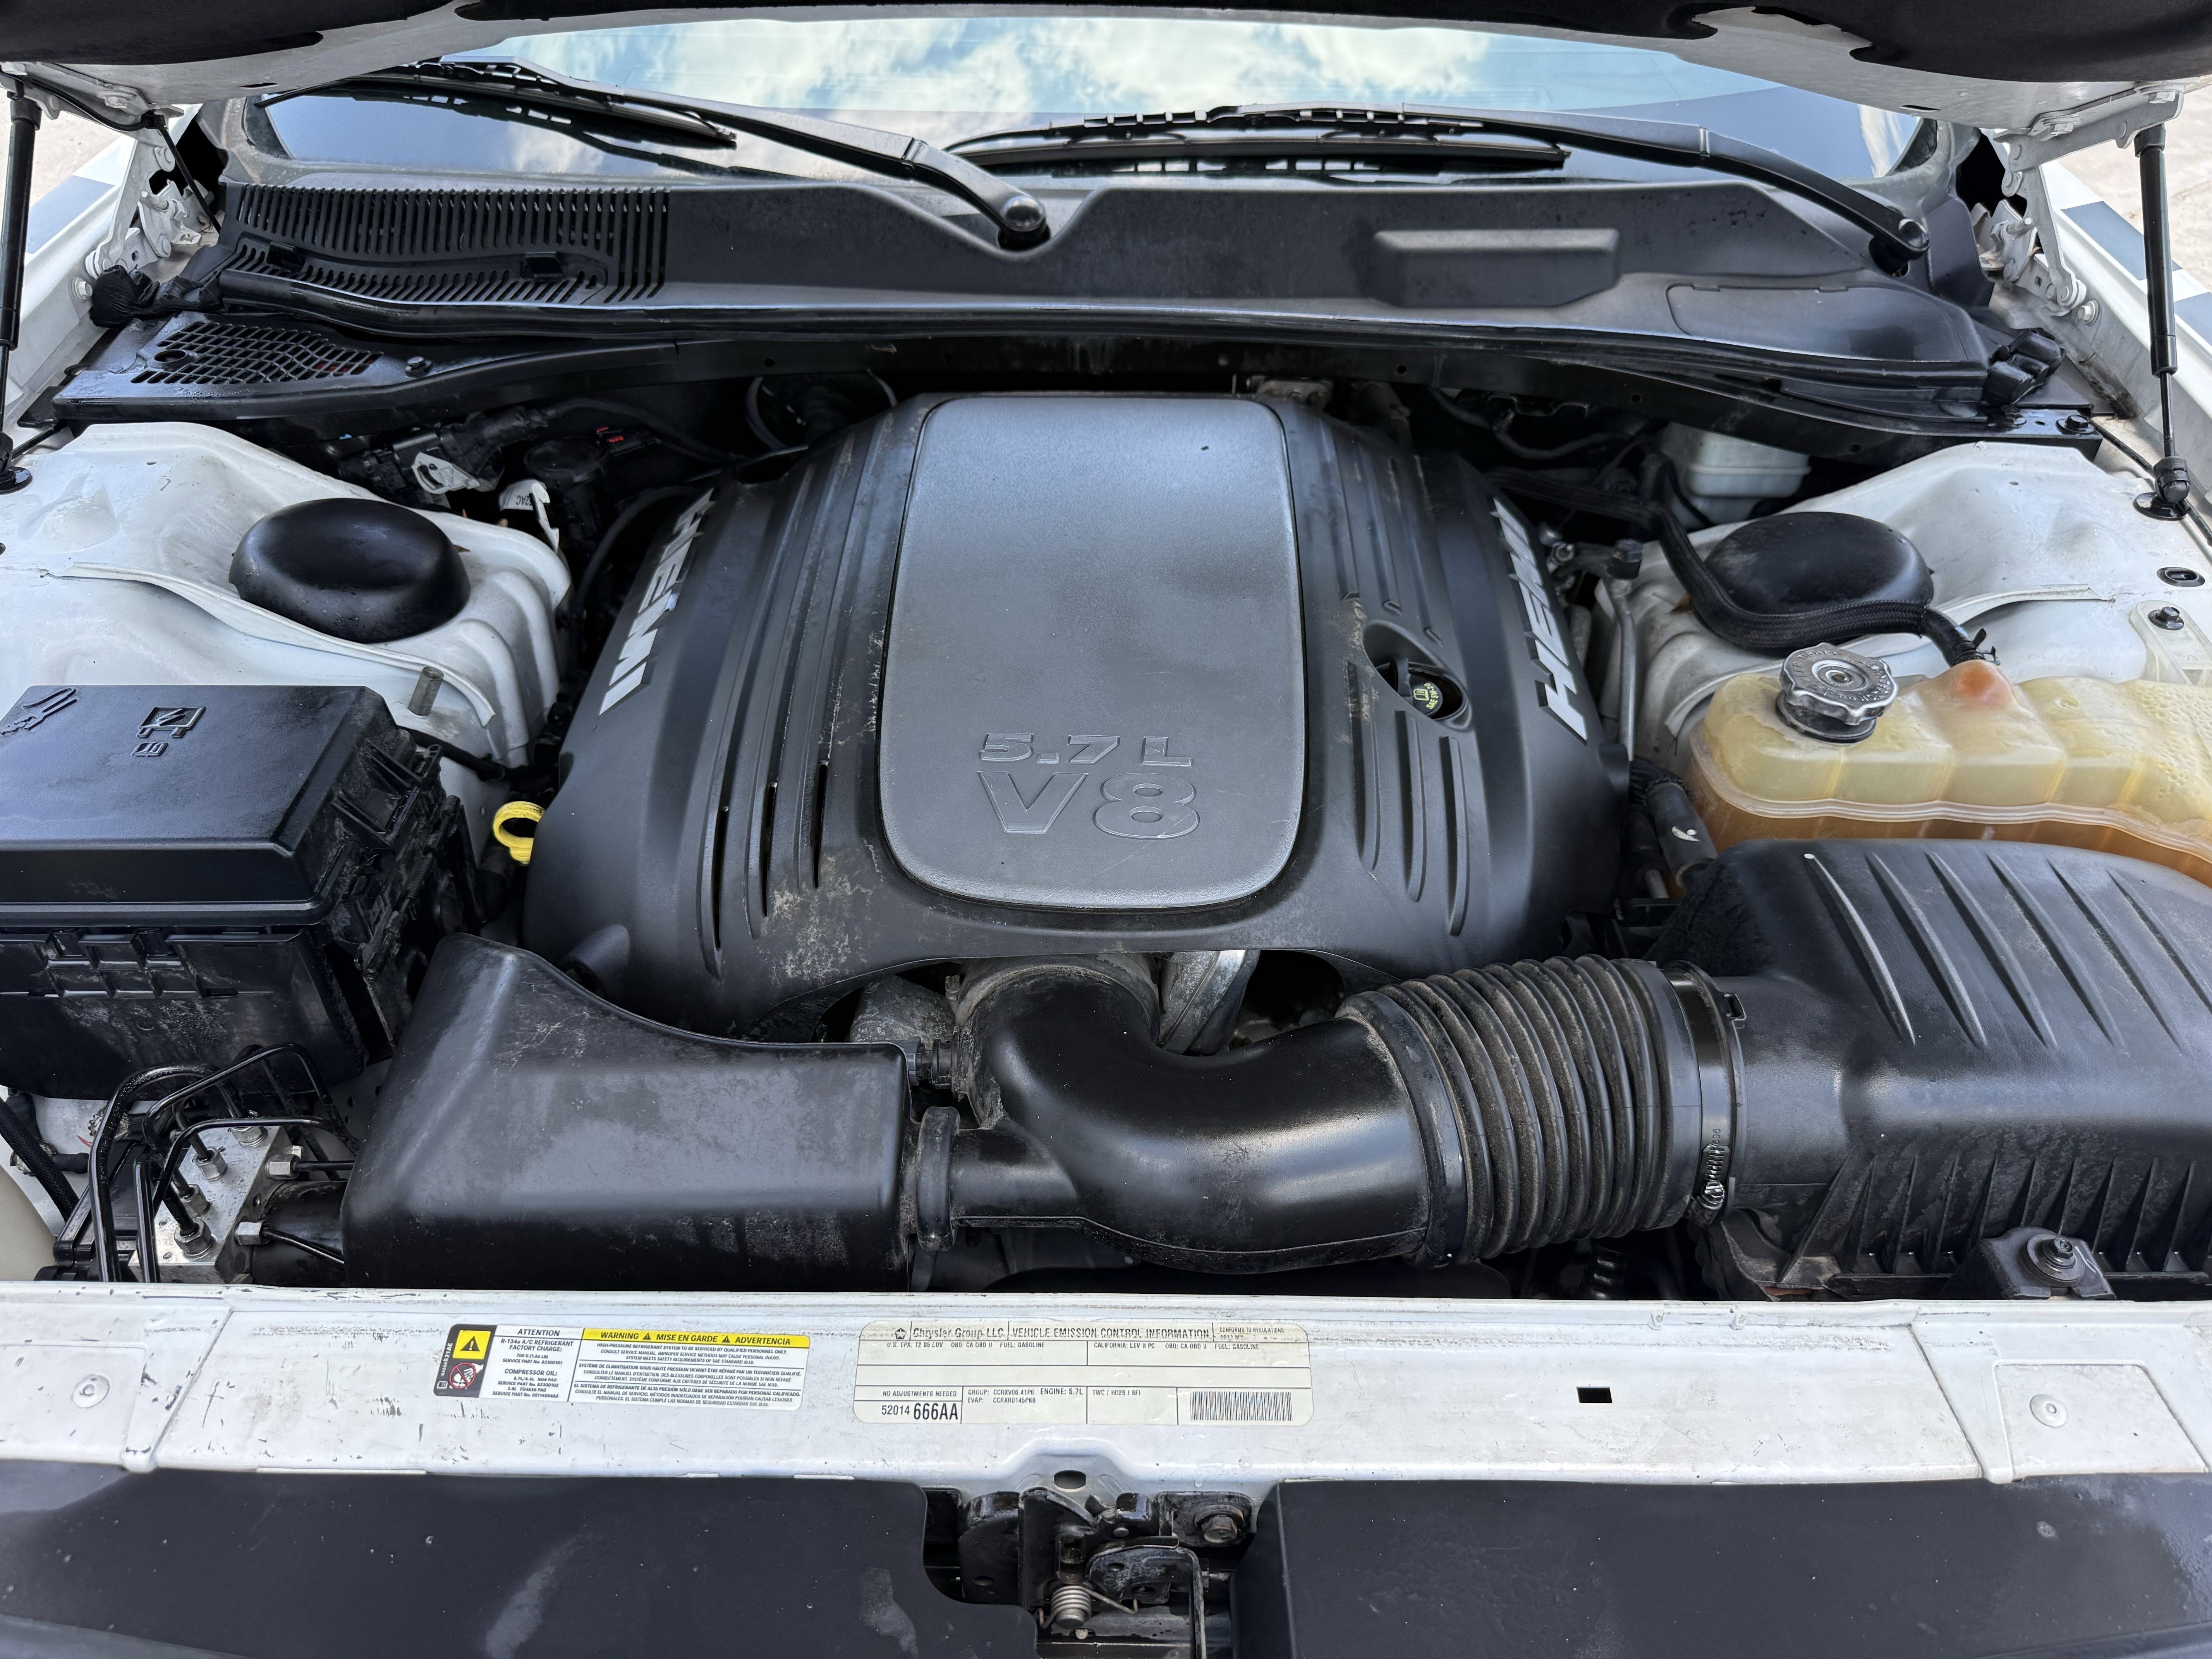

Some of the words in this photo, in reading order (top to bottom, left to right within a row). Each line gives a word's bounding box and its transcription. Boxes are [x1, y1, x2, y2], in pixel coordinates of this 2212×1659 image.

[516, 495, 532, 506] 2AC
[1492, 497, 1587, 743] HEMI
[1426, 699, 1438, 709] SAE
[976, 770, 1200, 840] V8
[601, 1331, 639, 1340] WARNING
[735, 1336, 790, 1345] ADVERTENCIA
[913, 1328, 952, 1339] Chrysler
[955, 1328, 984, 1340] Group
[987, 1328, 1005, 1338] LLC
[1013, 1328, 1050, 1338] VEHICLE
[1054, 1328, 1097, 1338] EMISSION
[1101, 1328, 1142, 1338] CONTROL
[1146, 1329, 1209, 1338] INFORMATION
[881, 1405, 910, 1415] 52014
[914, 1403, 958, 1420] 666AA
